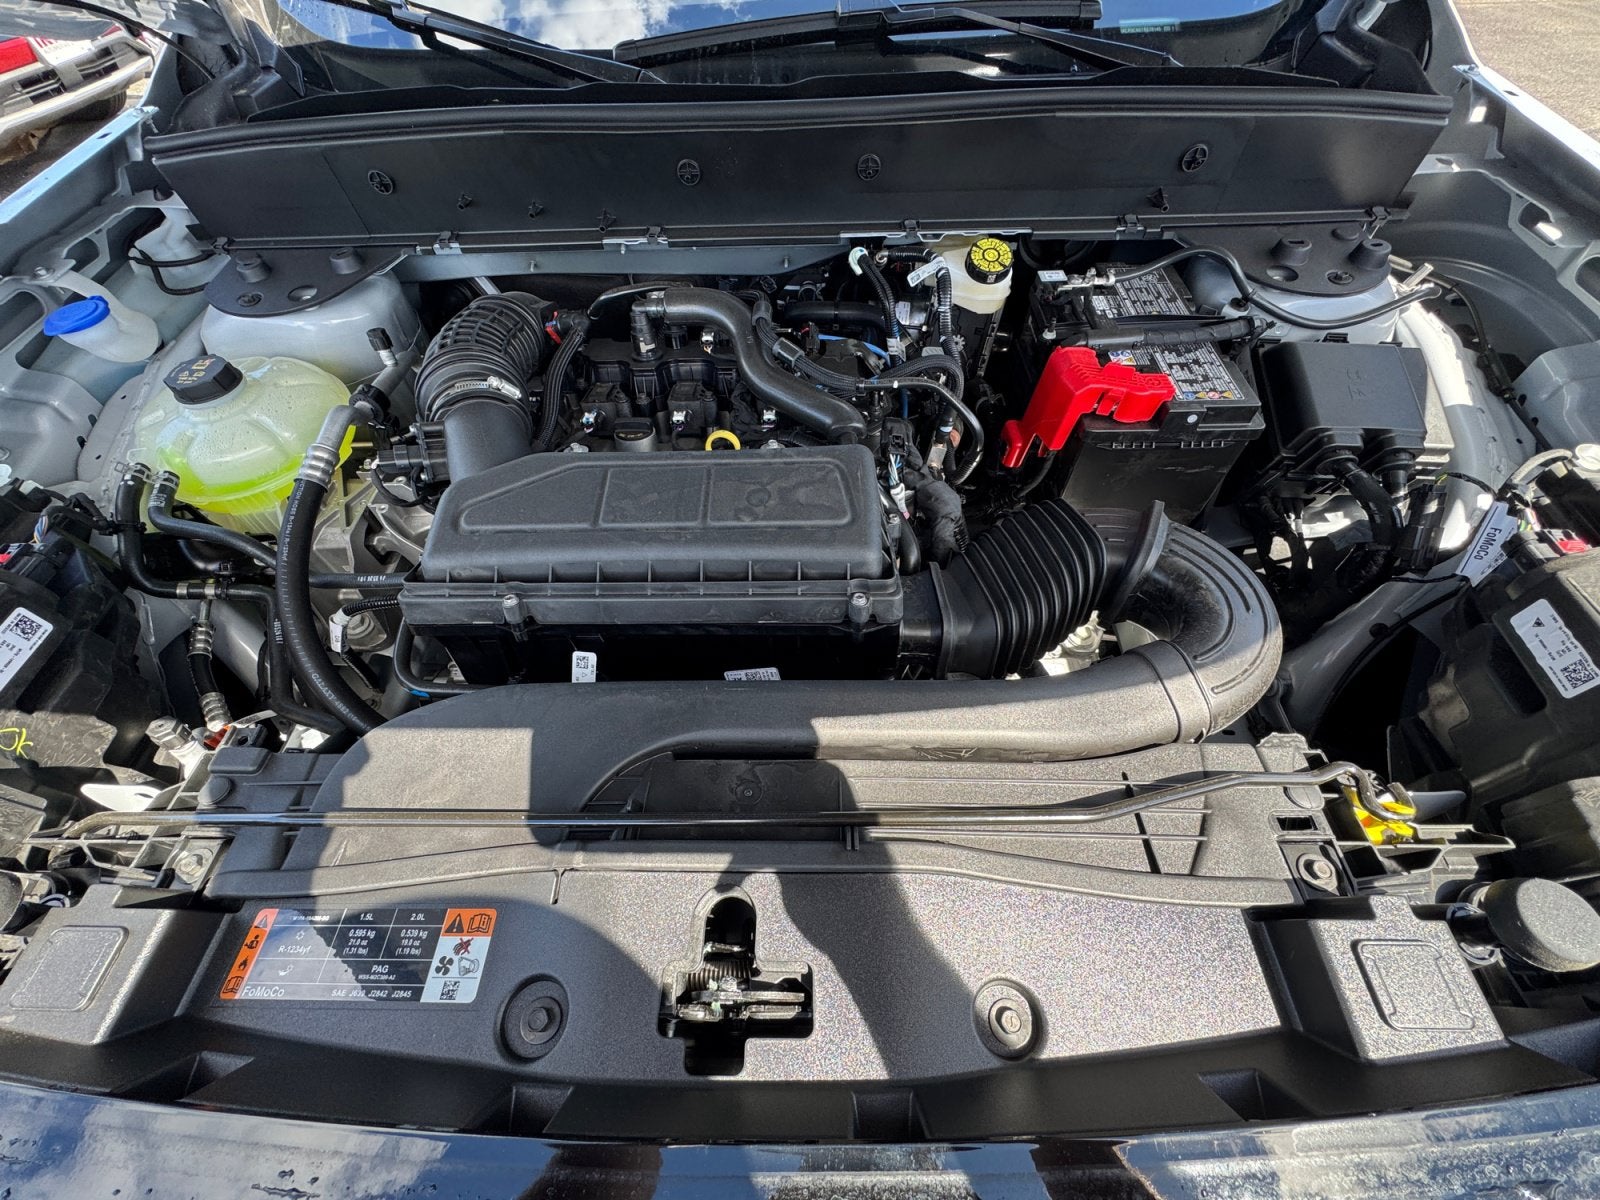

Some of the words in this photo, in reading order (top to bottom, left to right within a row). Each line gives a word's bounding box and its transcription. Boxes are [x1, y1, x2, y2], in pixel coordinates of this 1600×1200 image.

[1474, 527, 1502, 561] FoMoCo
[311, 672, 337, 702] GALAXY
[360, 913, 374, 921] 1.5L
[410, 913, 425, 921] 2.0L
[348, 929, 365, 937] 0.595
[366, 929, 376, 939] kg
[400, 929, 417, 937] 0.539
[418, 929, 428, 939] kg
[277, 944, 311, 954] R-1234yf
[371, 964, 389, 973] PAG
[241, 986, 285, 998] FoMoCo
[331, 989, 346, 997] SAE
[368, 990, 389, 998] J2842
[391, 990, 413, 998] J2845
